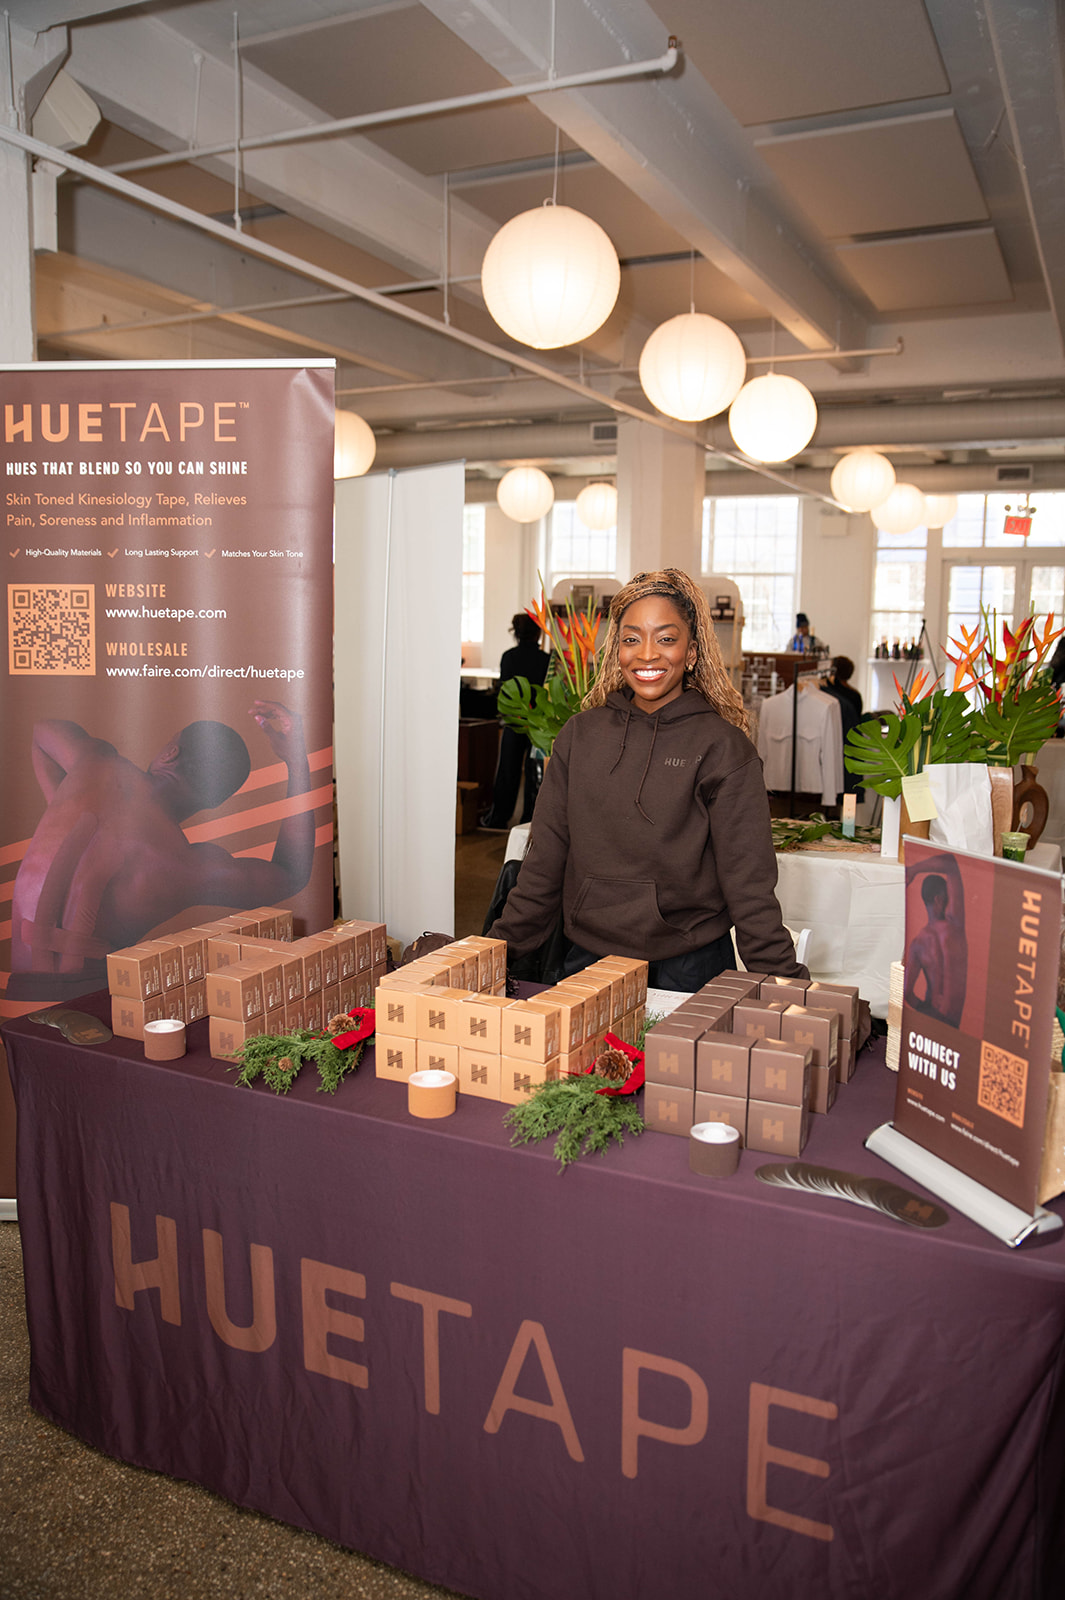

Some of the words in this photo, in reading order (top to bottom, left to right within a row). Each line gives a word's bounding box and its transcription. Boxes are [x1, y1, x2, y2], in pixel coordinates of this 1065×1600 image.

[6, 461, 37, 476] HUES
[43, 461, 74, 476] THAT
[80, 461, 119, 476] BLEND
[125, 461, 142, 476] SO
[147, 461, 173, 475] YOU
[178, 461, 204, 475] CAN
[209, 461, 248, 475] SHINE
[6, 493, 31, 506] Skin
[34, 493, 74, 506] Toned
[79, 493, 152, 509] Kinesiology
[155, 493, 190, 508] Tape,
[195, 492, 247, 506] Relieves
[7, 514, 35, 528] Pain,
[39, 514, 97, 527] Soreness
[100, 514, 124, 527] and
[128, 514, 213, 527] Inflammation
[25, 548, 69, 559] High-Quality
[70, 548, 102, 557] Materials
[124, 548, 143, 559] Long
[144, 548, 170, 559] Lasting
[170, 548, 199, 559] Support
[221, 549, 251, 558] Matches
[251, 550, 268, 558] Your
[269, 550, 284, 558] Skin
[285, 550, 304, 559] Tone
[105, 583, 167, 598] WEBSITE
[105, 605, 227, 622] www.huetape.com
[105, 642, 188, 657] WHOLESALE
[106, 664, 305, 682] www.faire.com/direct/huetape
[908, 1031, 960, 1069] CONNECT
[908, 1051, 937, 1080] WITH
[941, 1069, 957, 1090] US
[110, 1201, 838, 1542] HUETAPE
